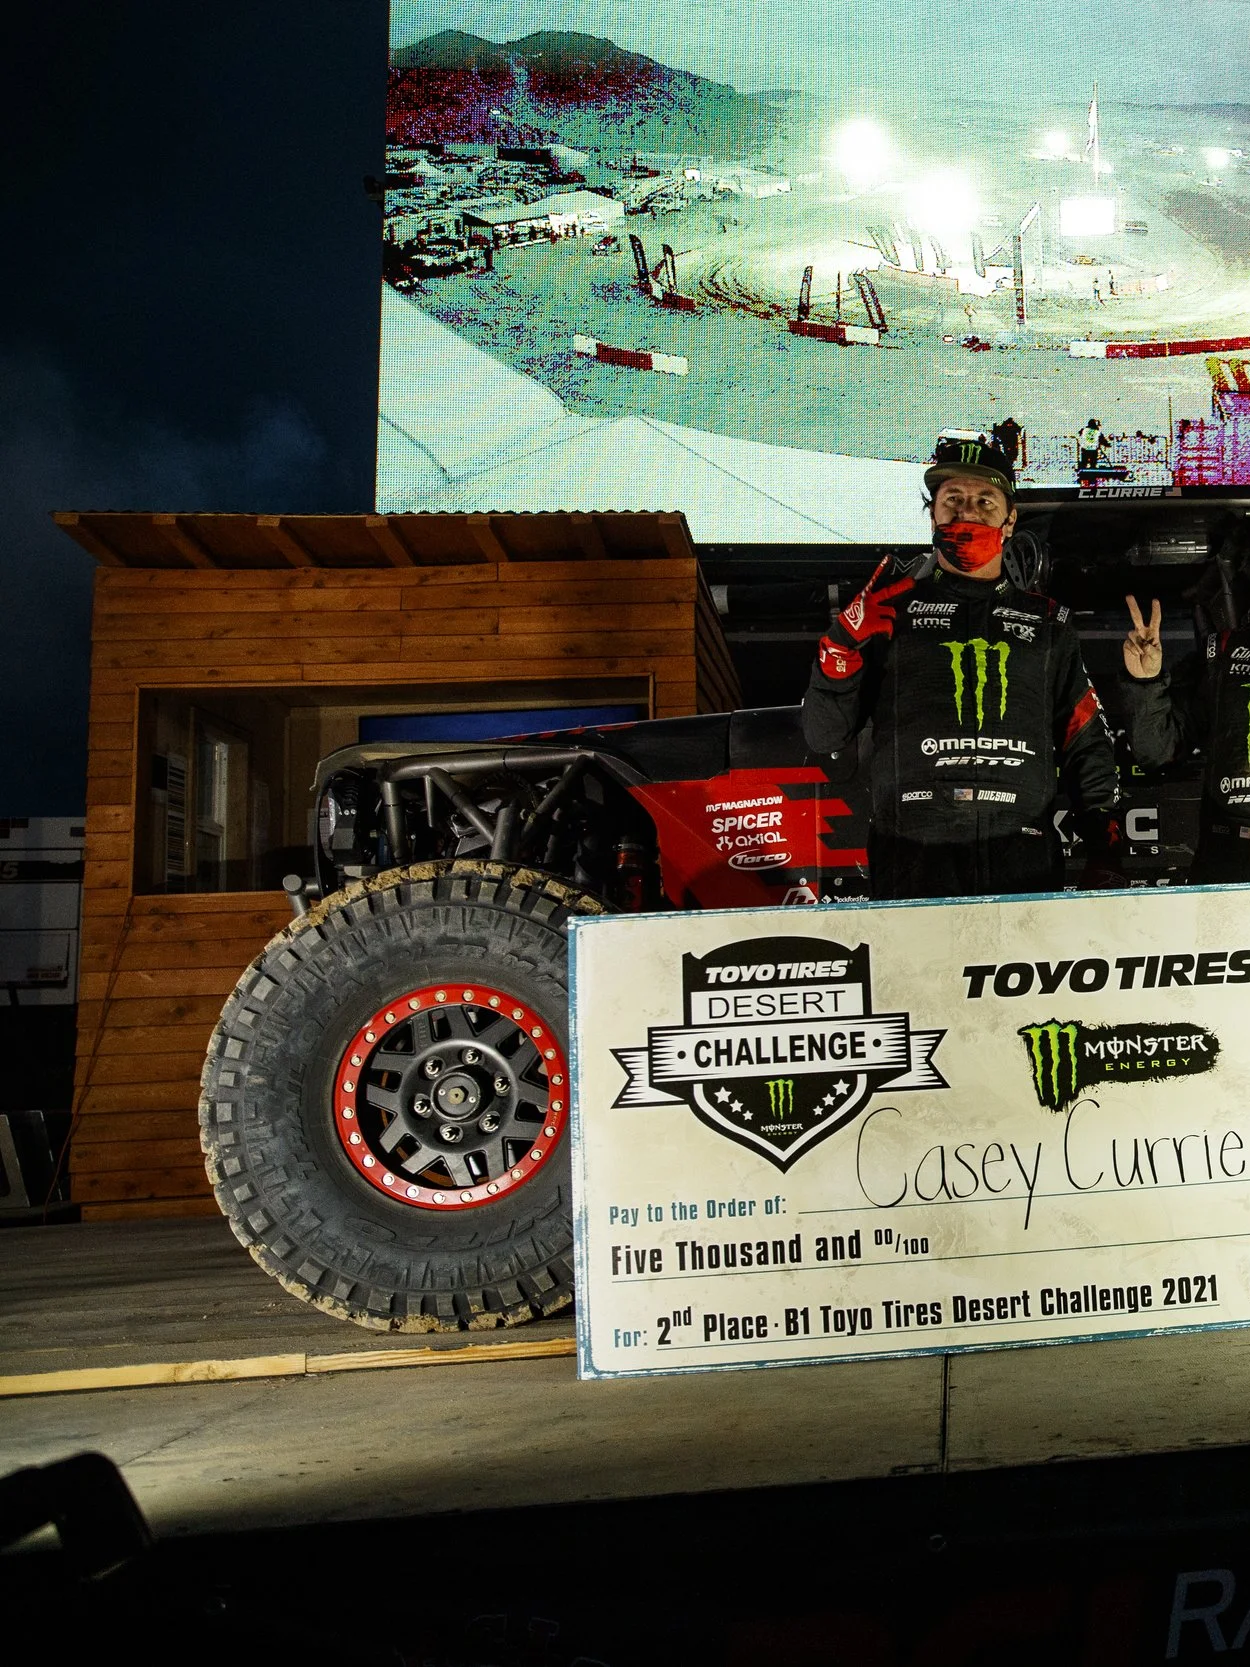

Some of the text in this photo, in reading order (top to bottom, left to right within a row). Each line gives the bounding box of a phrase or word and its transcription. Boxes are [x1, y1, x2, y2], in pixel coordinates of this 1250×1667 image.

[1078, 487, 1163, 499] C.CURRIE
[907, 600, 959, 614] CURRIE
[912, 617, 951, 628] KMC
[1002, 621, 1036, 642] FOX
[939, 737, 1036, 756] MAGPUL
[935, 755, 1025, 767] NITTO
[721, 796, 783, 811] MAGNAFLOW
[976, 789, 1017, 804] QUESADA
[711, 811, 783, 834] SPICER
[735, 852, 788, 865] Torco
[705, 959, 849, 984] TOYO TIRES
[961, 956, 1111, 999] TOYO
[708, 989, 846, 1020] DESERT
[693, 1030, 867, 1068] CHALLENGE
[1084, 1032, 1210, 1062] MONSTER
[1105, 1056, 1191, 1072] ENERGY
[760, 1123, 804, 1132] MONSTER
[856, 1098, 1247, 1230] Casey Currie
[609, 1195, 787, 1229] Pay to the Order of:
[611, 1243, 663, 1277] Five
[675, 1232, 802, 1272] Thousand
[815, 1228, 861, 1261] and
[614, 1274, 1218, 1349] For: 2nd Place B1 Toyo Tires Desert Challenge 2021
